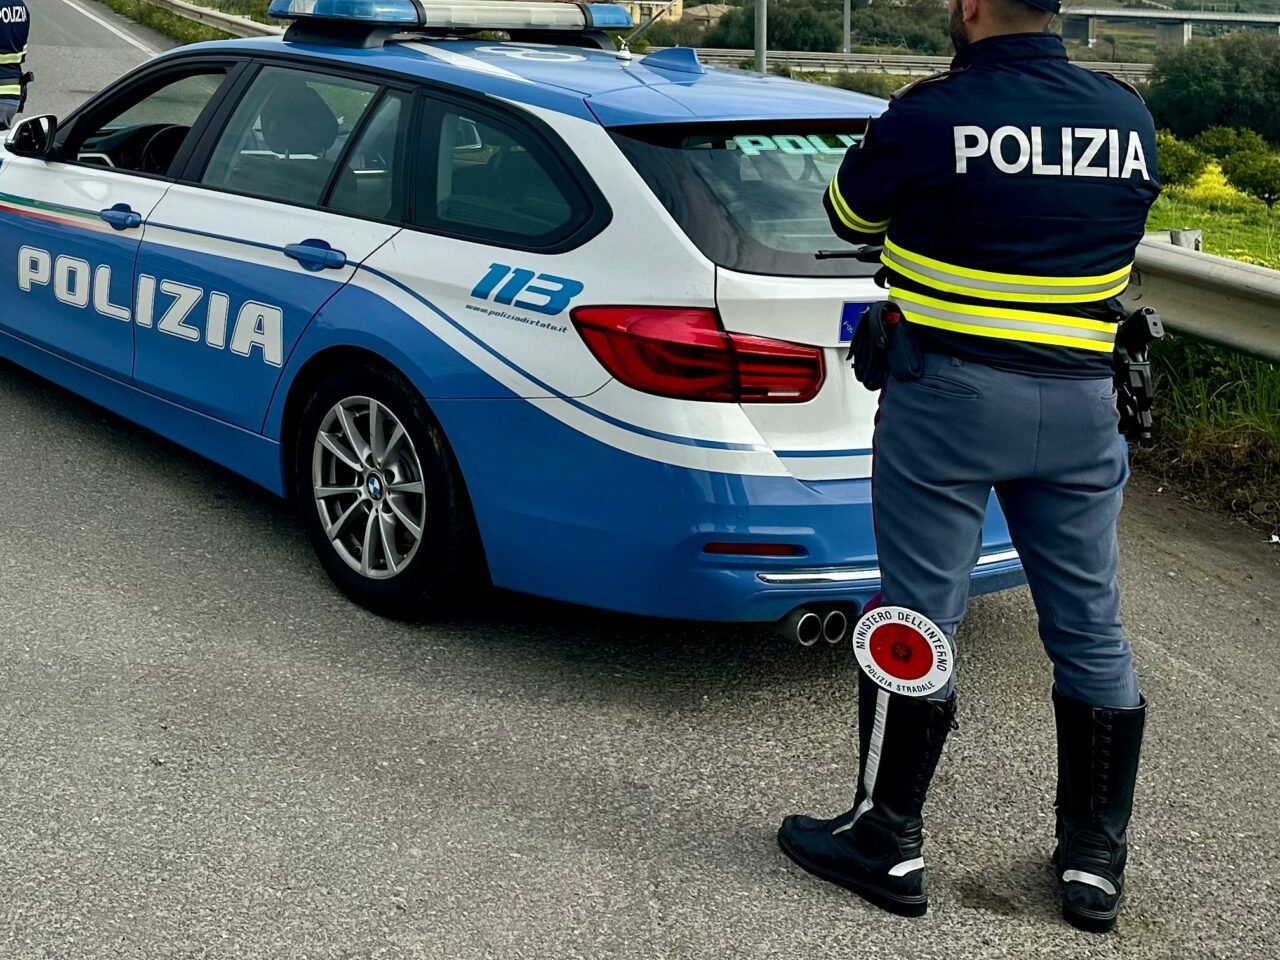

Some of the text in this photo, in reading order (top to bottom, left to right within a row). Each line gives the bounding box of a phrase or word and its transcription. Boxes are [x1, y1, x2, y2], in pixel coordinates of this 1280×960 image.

[733, 134, 866, 156] POLI
[953, 125, 1150, 181] POLIZIA
[17, 244, 284, 368] POLIZIA
[470, 262, 585, 316] 113
[465, 303, 568, 334] www.poliziadistato.it
[856, 610, 948, 672] MINISTERO DELL'INTERNO
[864, 664, 935, 693] POLIZIA STRADALE
